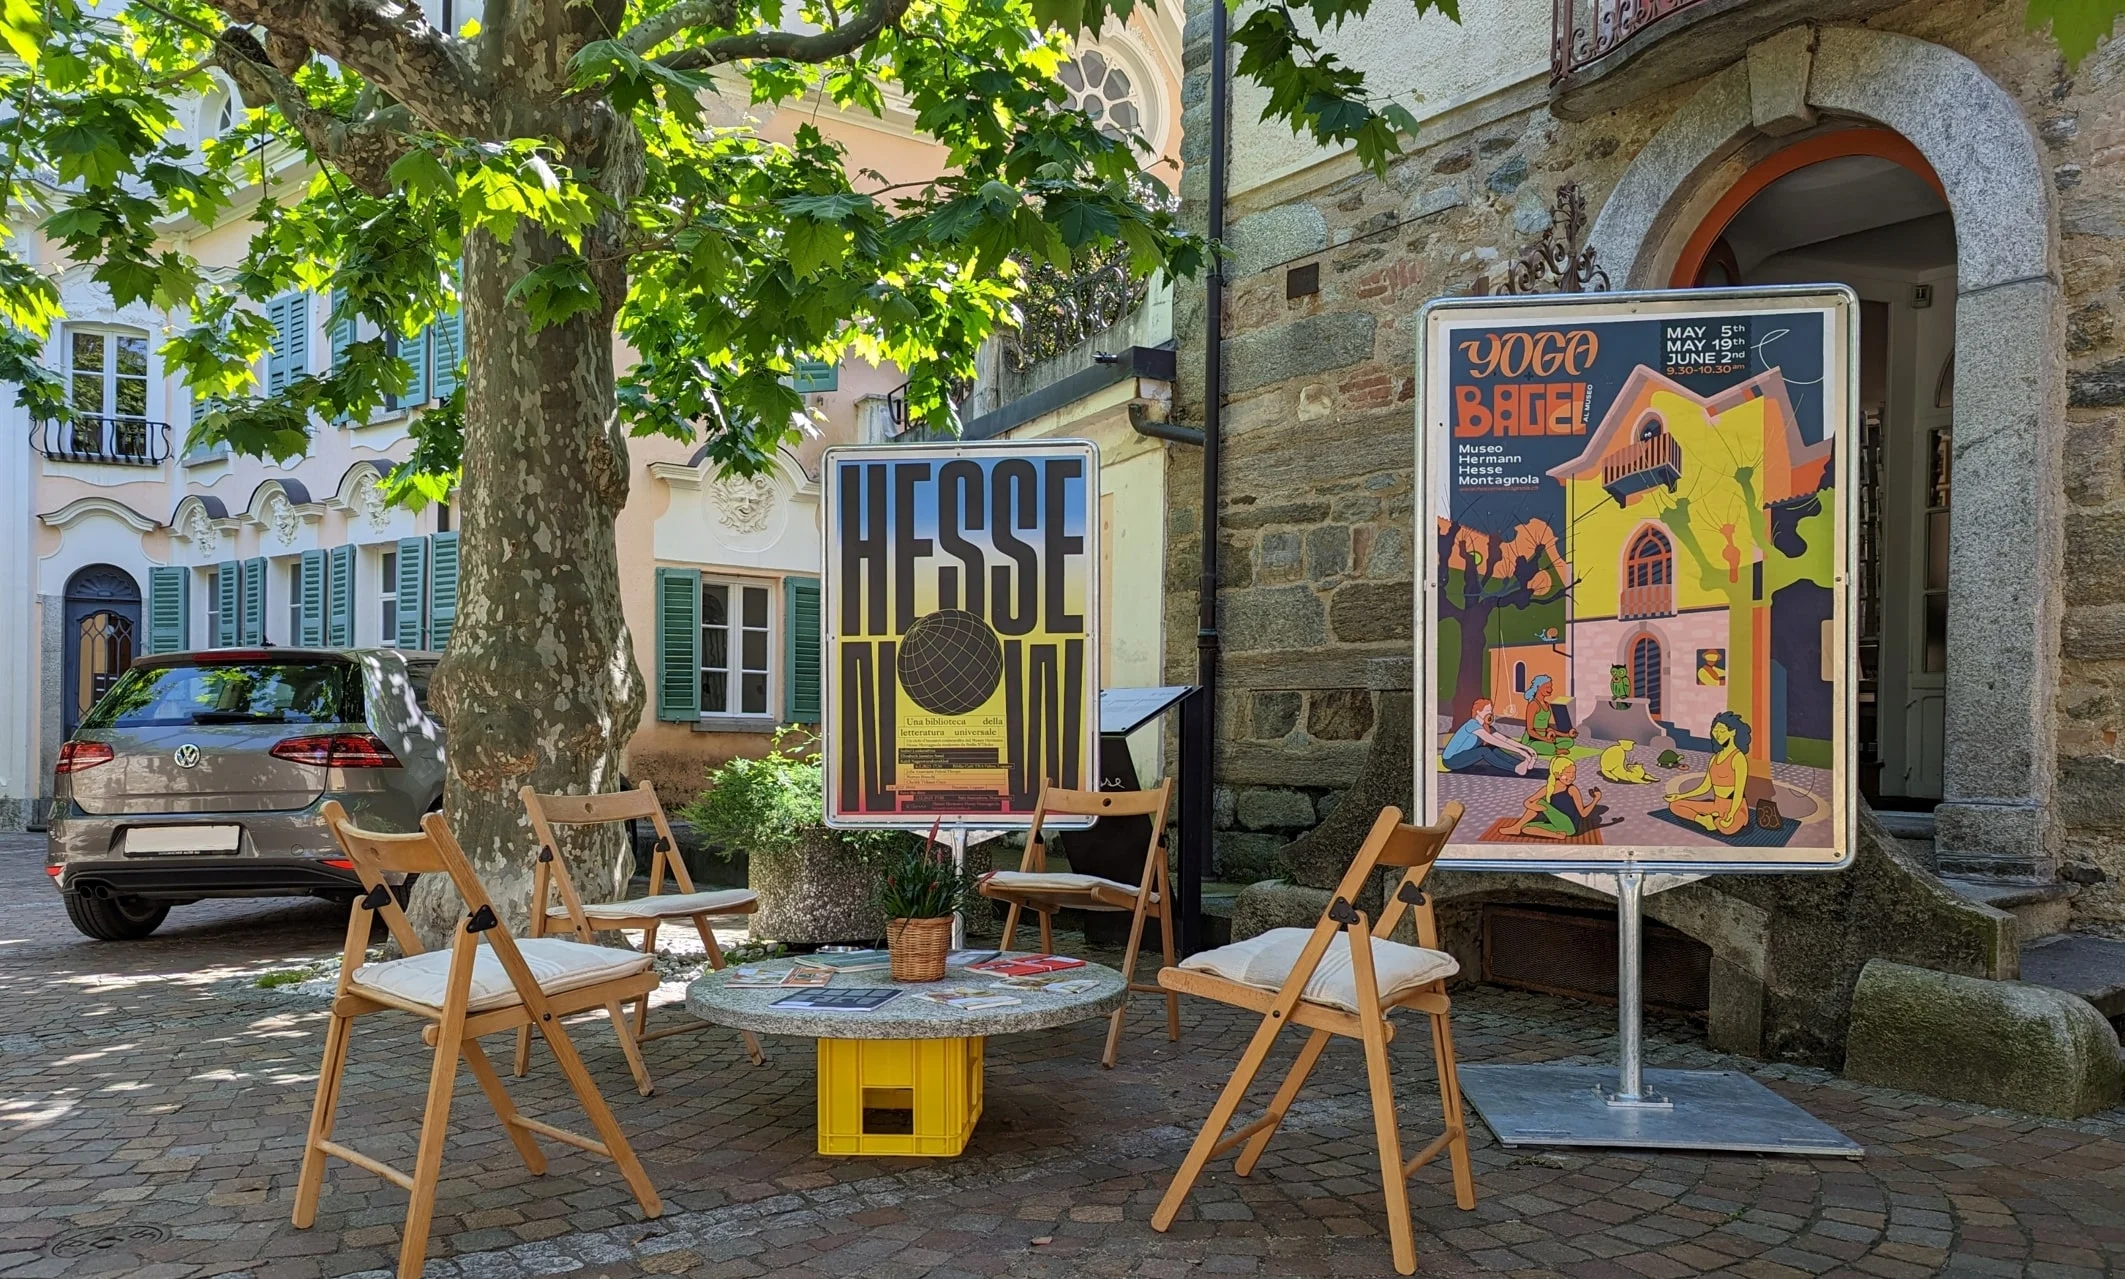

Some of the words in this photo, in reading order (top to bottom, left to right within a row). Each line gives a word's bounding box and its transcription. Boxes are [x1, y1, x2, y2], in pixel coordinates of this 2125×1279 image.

[1667, 326, 1706, 339] MAY
[1721, 325, 1745, 337] 5th
[1667, 339, 1706, 352] MAY
[1712, 338, 1745, 350] 19th
[1458, 330, 1598, 378] YOGA
[1666, 352, 1716, 365] JUNE
[1721, 351, 1745, 363] 2nd
[1584, 384, 1593, 411] MUSEO
[1454, 382, 1586, 437] BAGEL
[1583, 411, 1590, 422] AL
[1459, 444, 1503, 453] Museo
[1459, 455, 1522, 464] Hermann
[1459, 465, 1503, 475] Hesse
[1459, 475, 1539, 487] Montagnola
[841, 459, 1084, 636] HESSE
[906, 717, 923, 726] Una
[925, 717, 966, 726] biblioteca
[982, 717, 1003, 725] della
[900, 728, 945, 737] letteratura
[954, 727, 997, 736] universale
